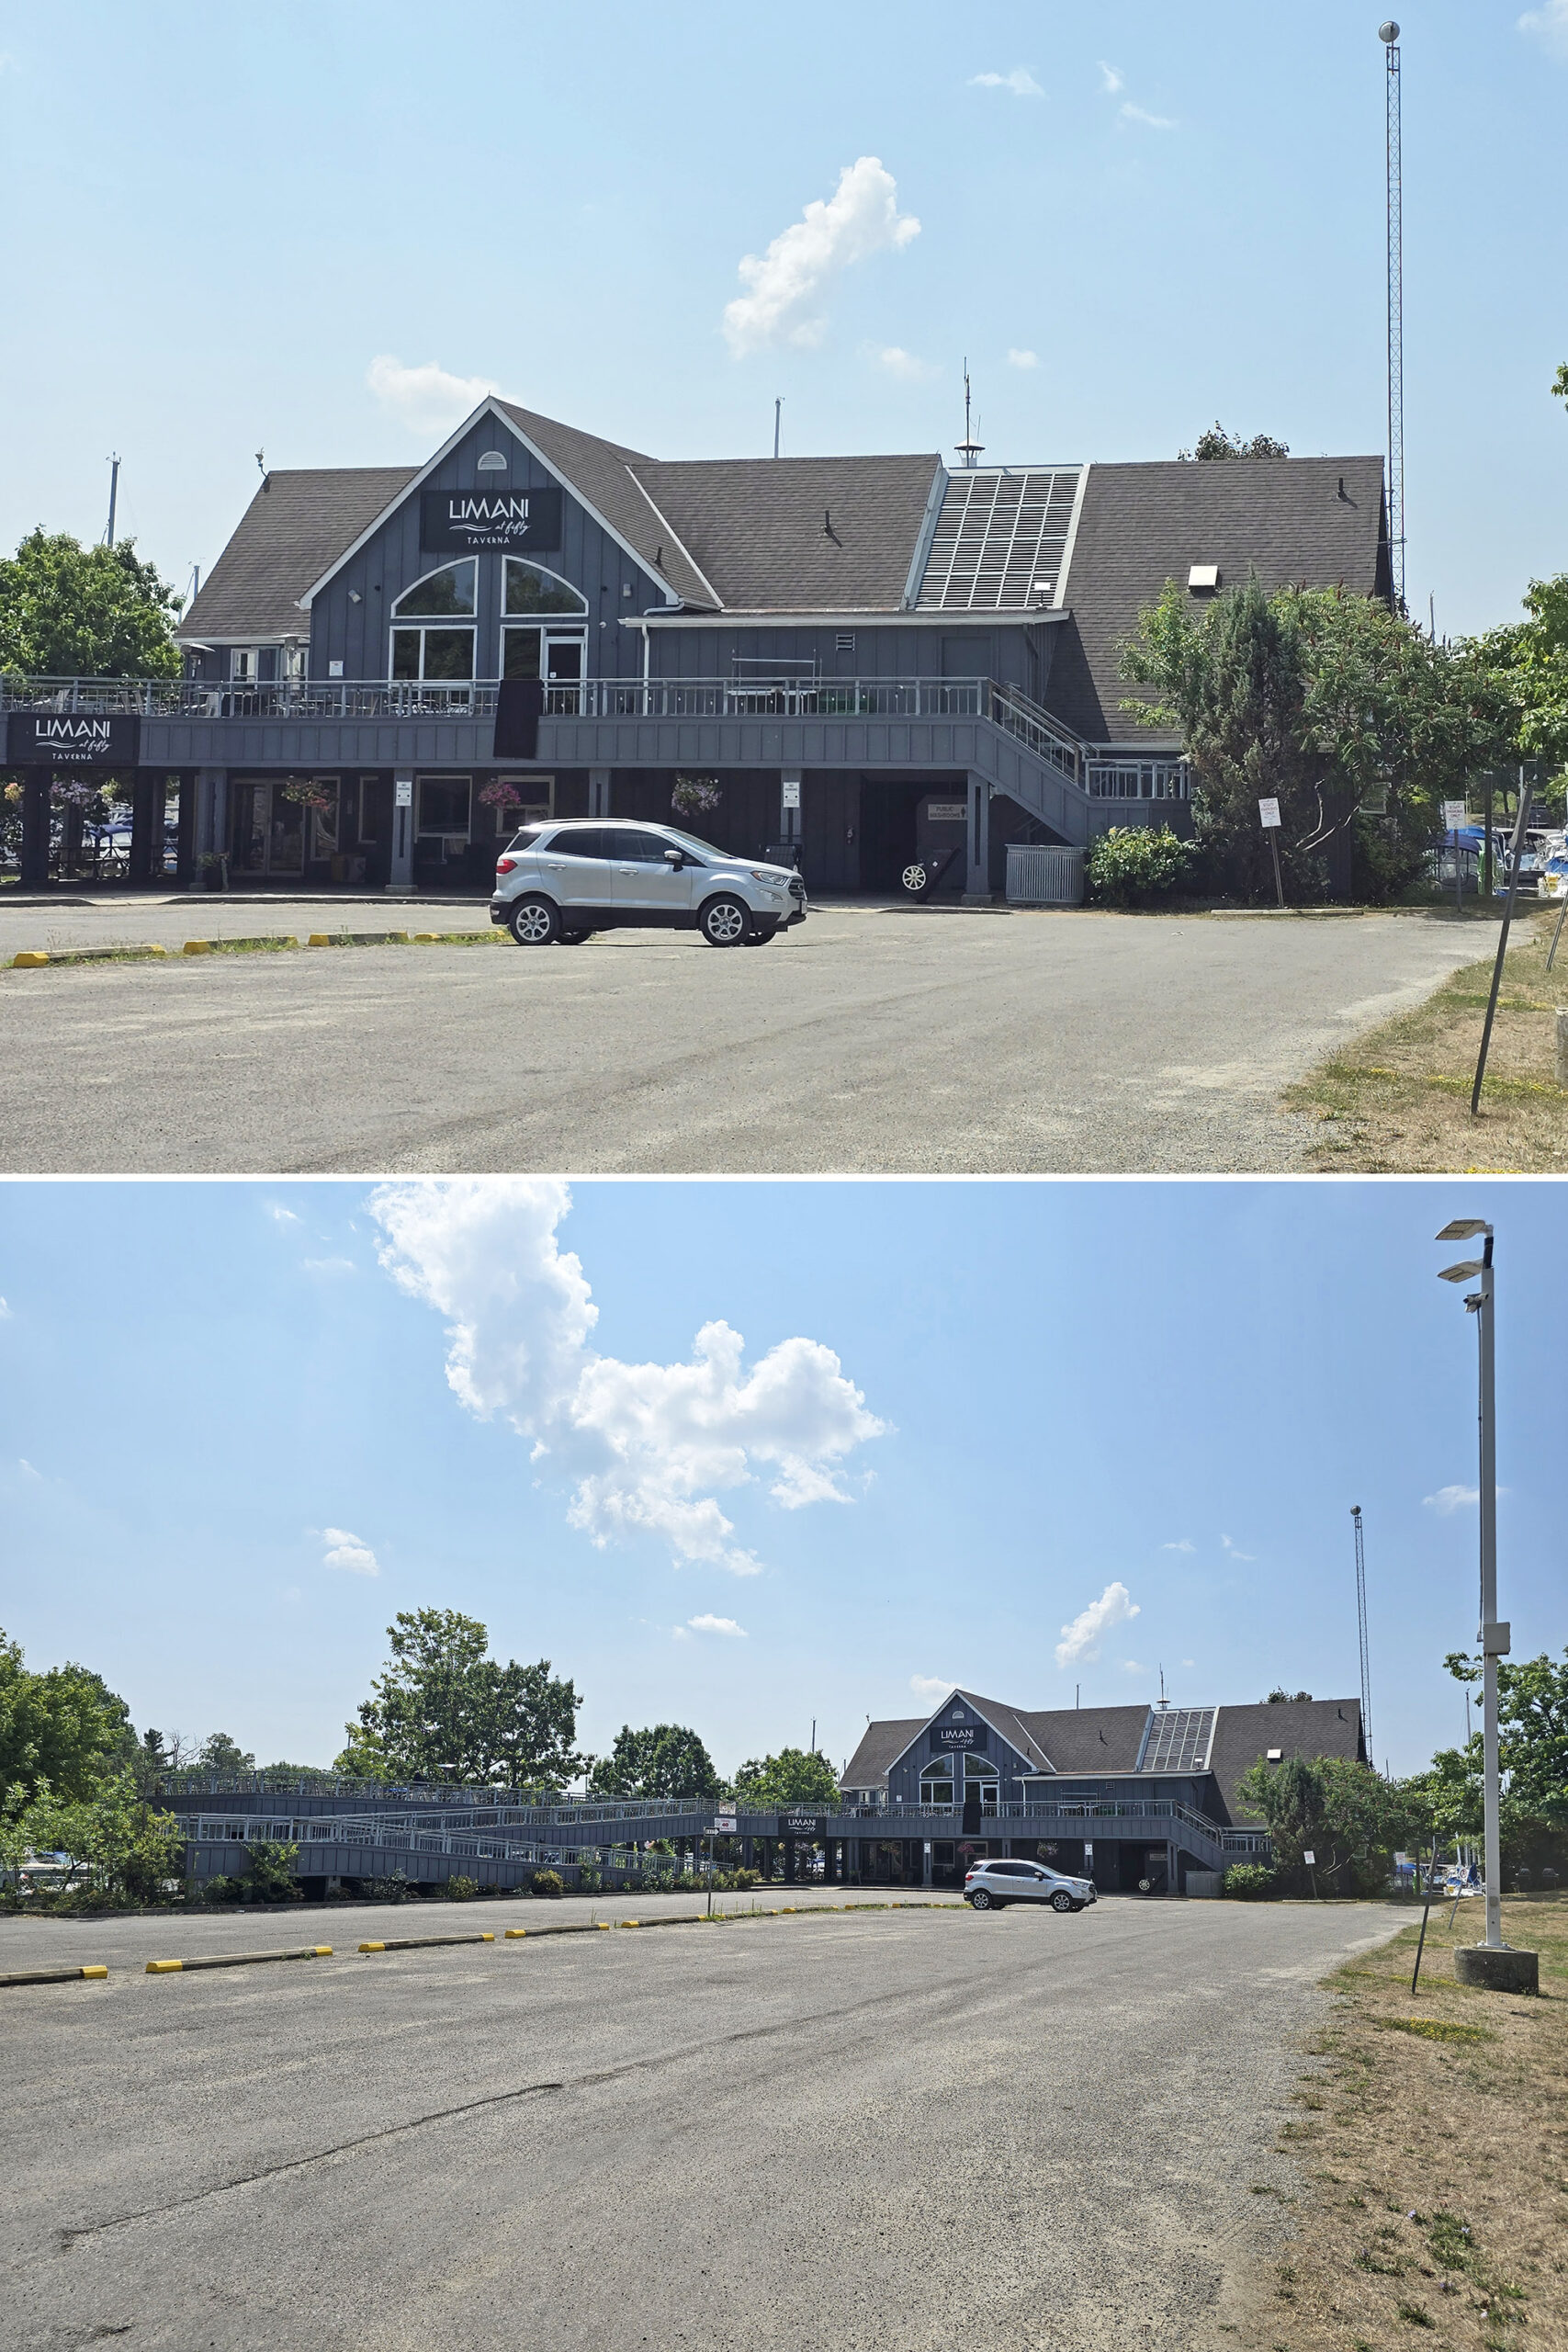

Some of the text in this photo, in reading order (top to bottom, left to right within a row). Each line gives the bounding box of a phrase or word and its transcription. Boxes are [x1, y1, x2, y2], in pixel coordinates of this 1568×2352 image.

[449, 497, 529, 520] LIMANI
[494, 520, 532, 536] at fifty
[36, 718, 110, 739] LIMANI
[86, 739, 112, 752] fifty
[941, 1729, 974, 1739] LIMANI
